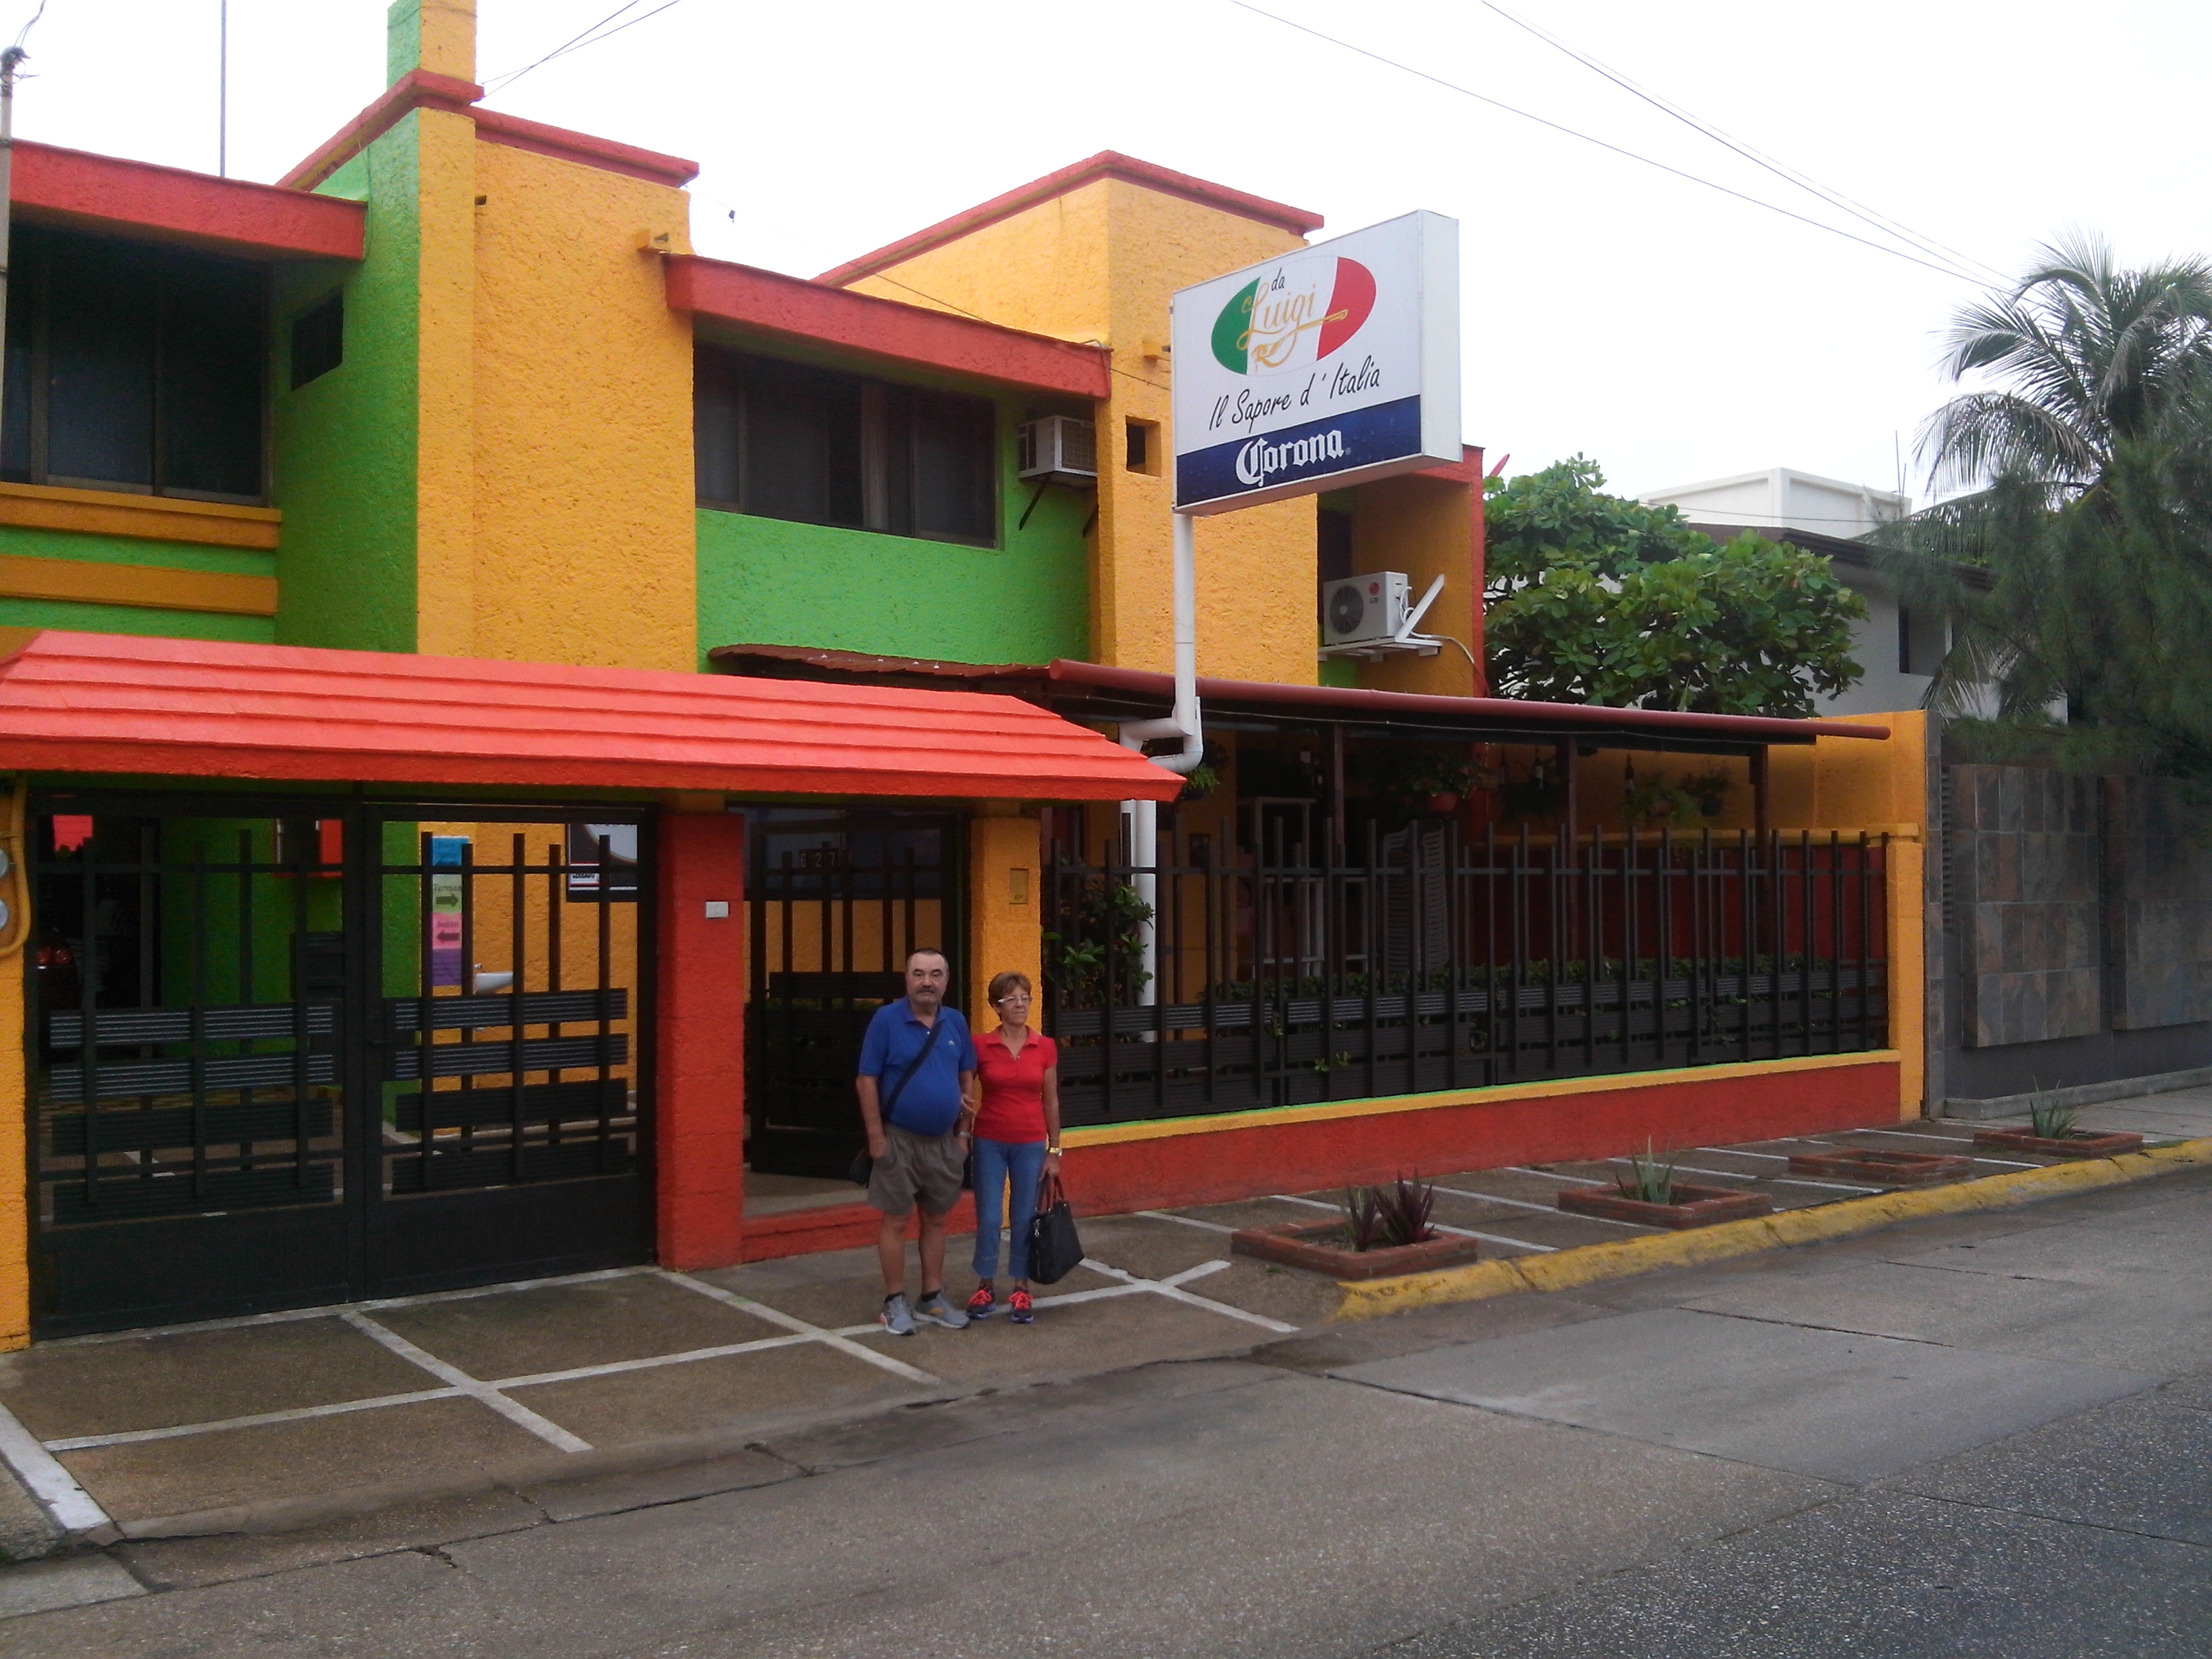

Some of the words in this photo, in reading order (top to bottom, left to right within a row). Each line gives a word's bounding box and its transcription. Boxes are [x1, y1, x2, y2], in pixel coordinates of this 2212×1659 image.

[1271, 268, 1286, 291] da
[1237, 283, 1317, 367] Luigi
[1209, 394, 1229, 431] Il
[1231, 388, 1292, 434] Sapore
[1235, 429, 1345, 487] Corona
